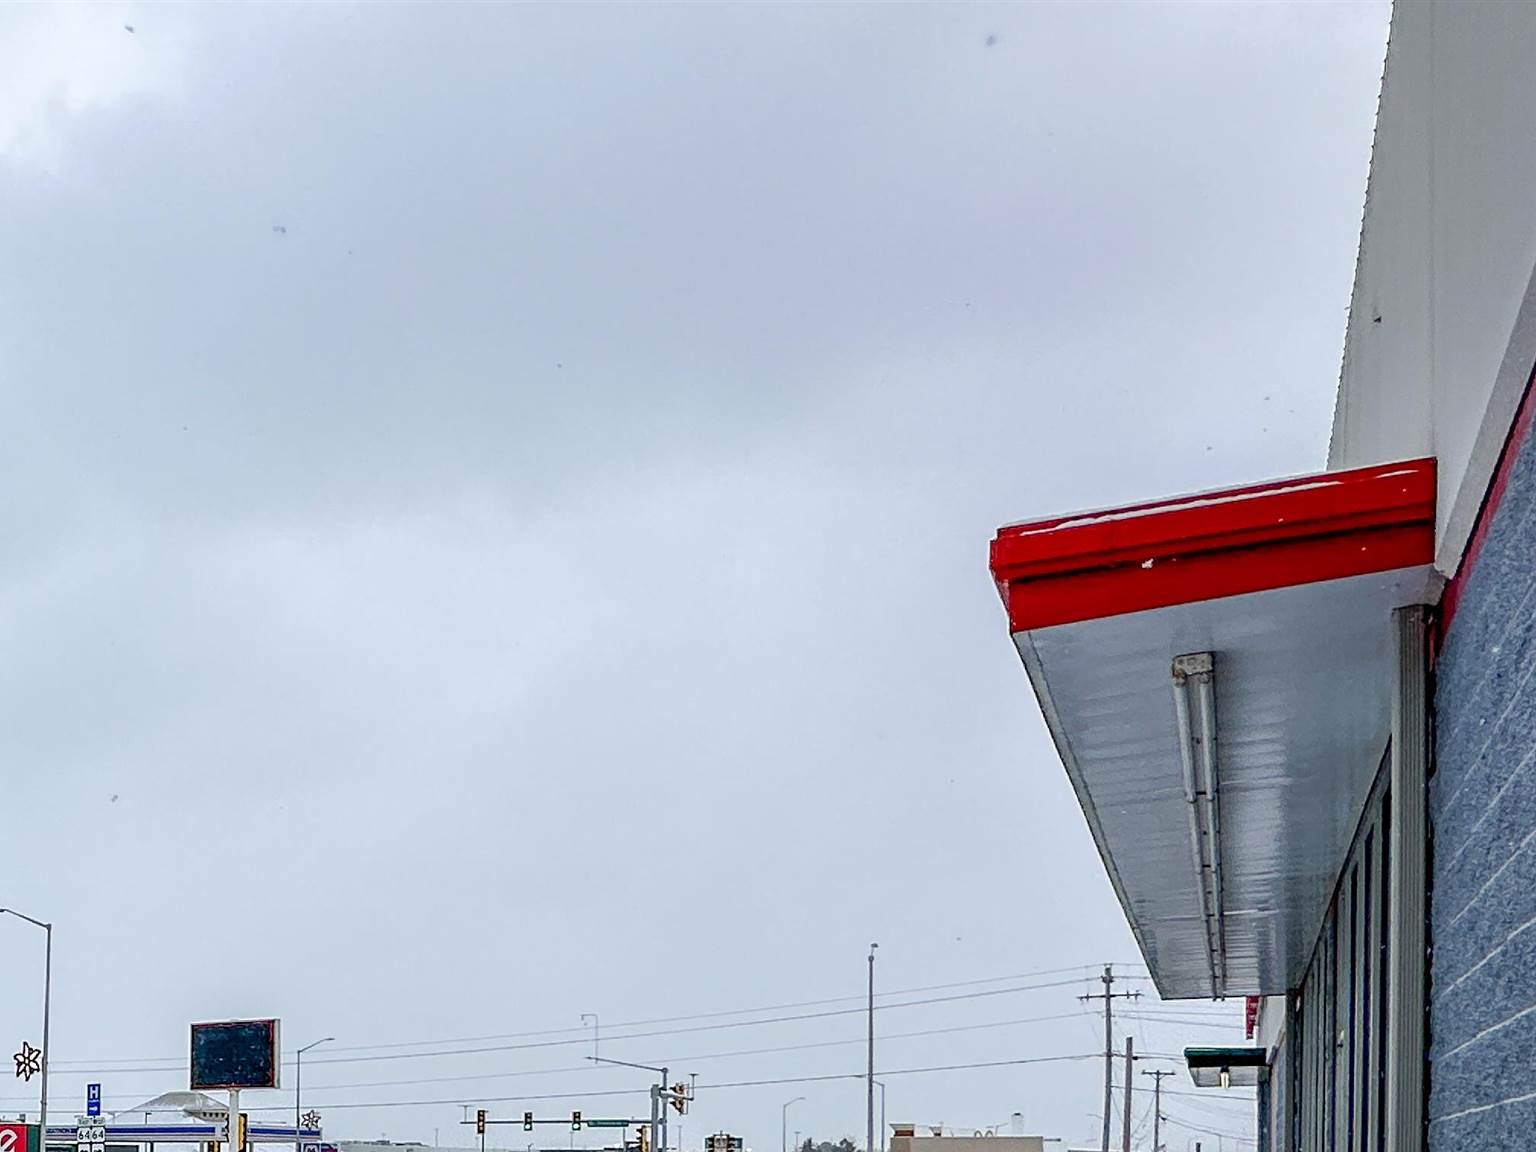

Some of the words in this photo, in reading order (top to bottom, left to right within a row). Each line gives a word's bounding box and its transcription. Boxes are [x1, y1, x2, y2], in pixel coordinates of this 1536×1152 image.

[89, 1086, 99, 1099] H
[78, 1130, 90, 1140] 64
[92, 1130, 104, 1140] 64
